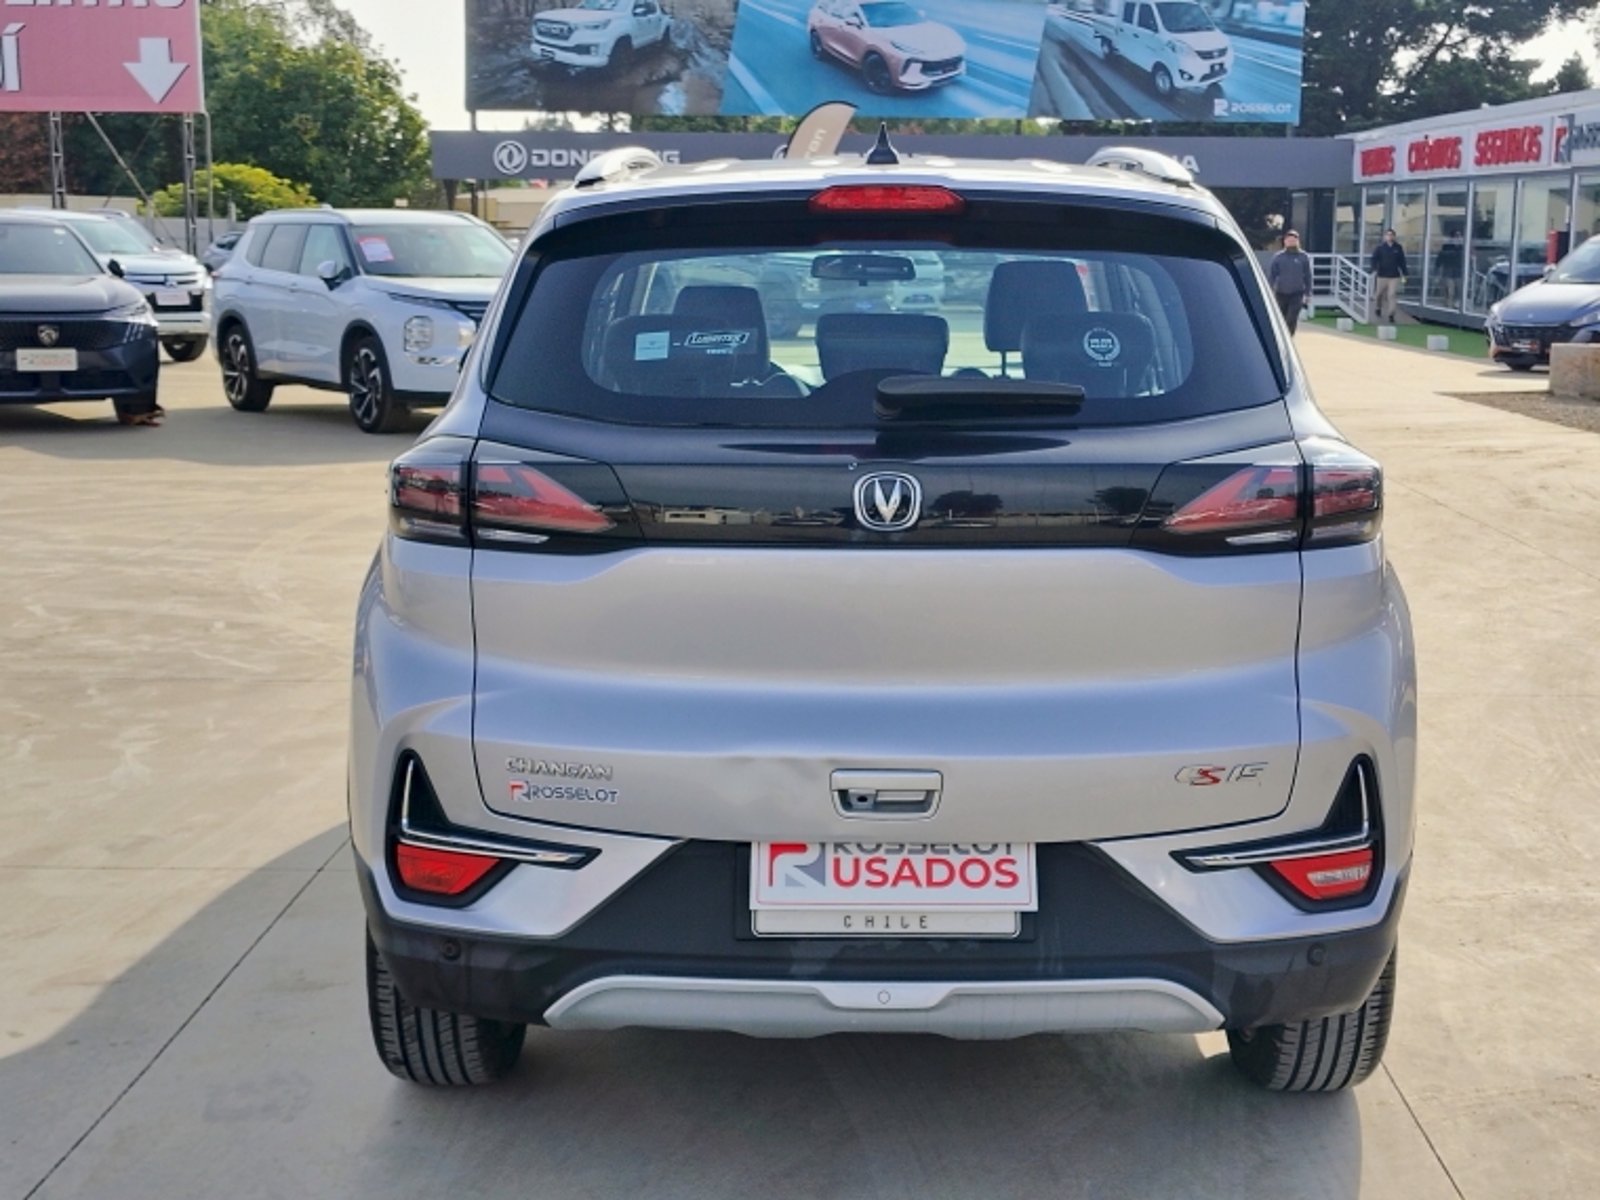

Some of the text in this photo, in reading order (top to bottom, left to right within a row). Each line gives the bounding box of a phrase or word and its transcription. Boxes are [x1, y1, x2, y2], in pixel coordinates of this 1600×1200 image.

[1474, 126, 1544, 166] SEGUROS
[505, 756, 614, 781] CHANGAN
[531, 785, 618, 803] ROSSELOT
[832, 856, 1020, 889] USADOS
[843, 915, 928, 929] CHILE
